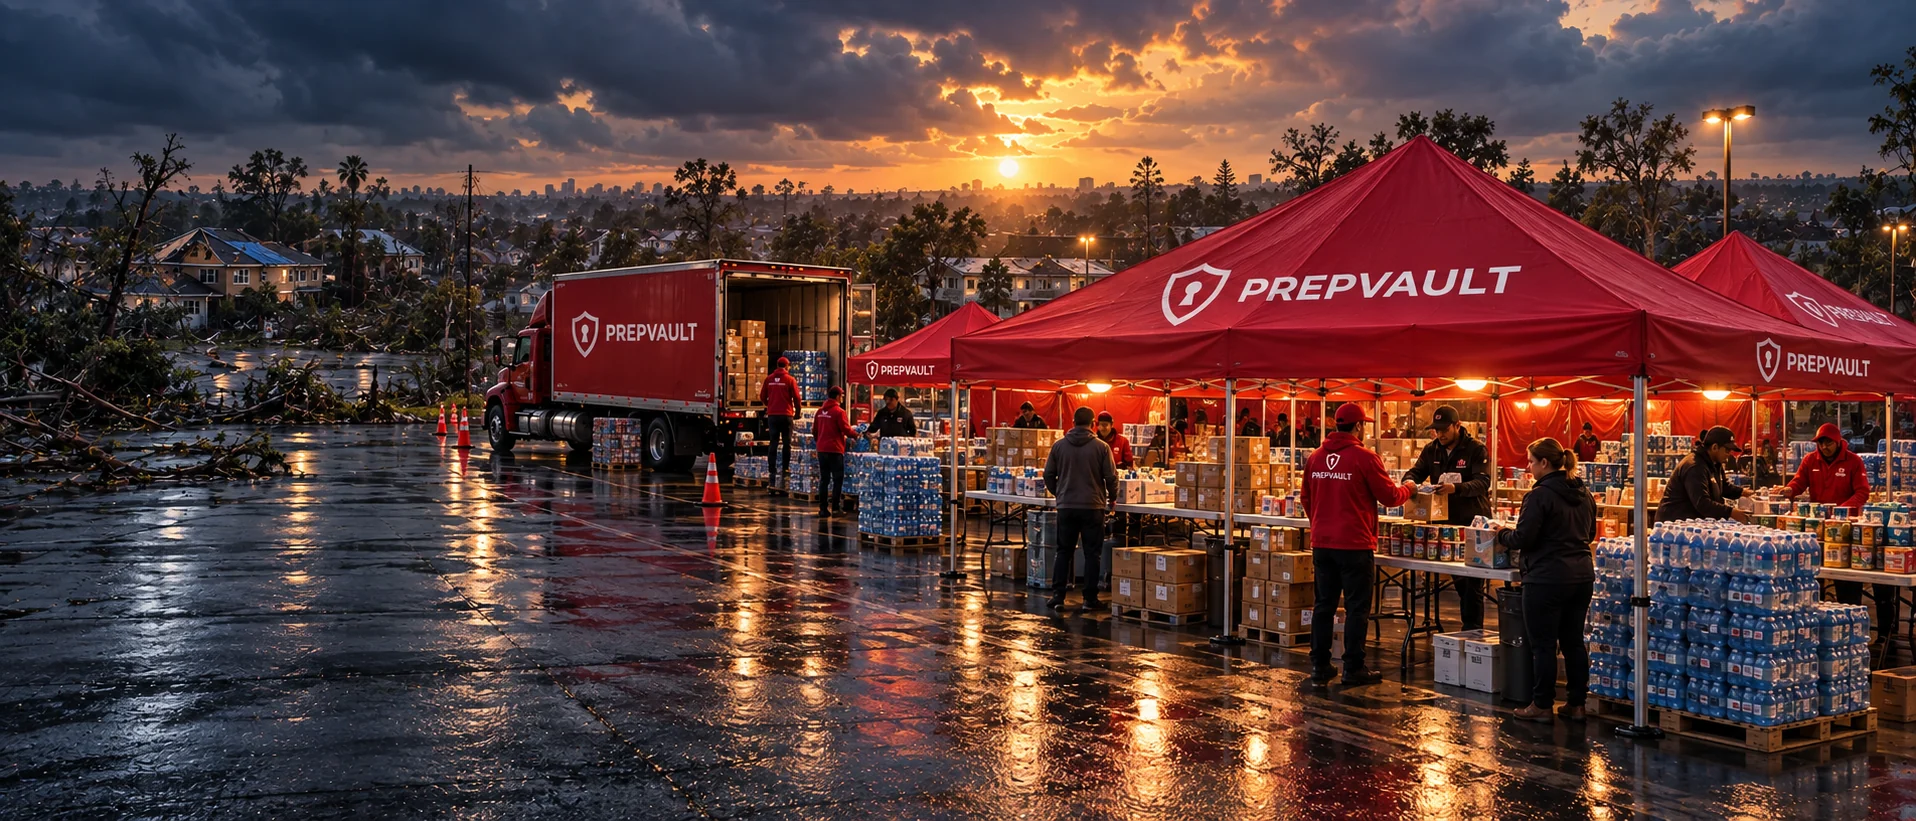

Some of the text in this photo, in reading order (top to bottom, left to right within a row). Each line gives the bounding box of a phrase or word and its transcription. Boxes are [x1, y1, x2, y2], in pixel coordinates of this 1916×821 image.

[1237, 266, 1521, 303] PREPVAULT
[606, 323, 698, 342] PREPVAULT
[881, 365, 935, 376] PREPVAULT
[1787, 352, 1871, 377] PREPVAULT
